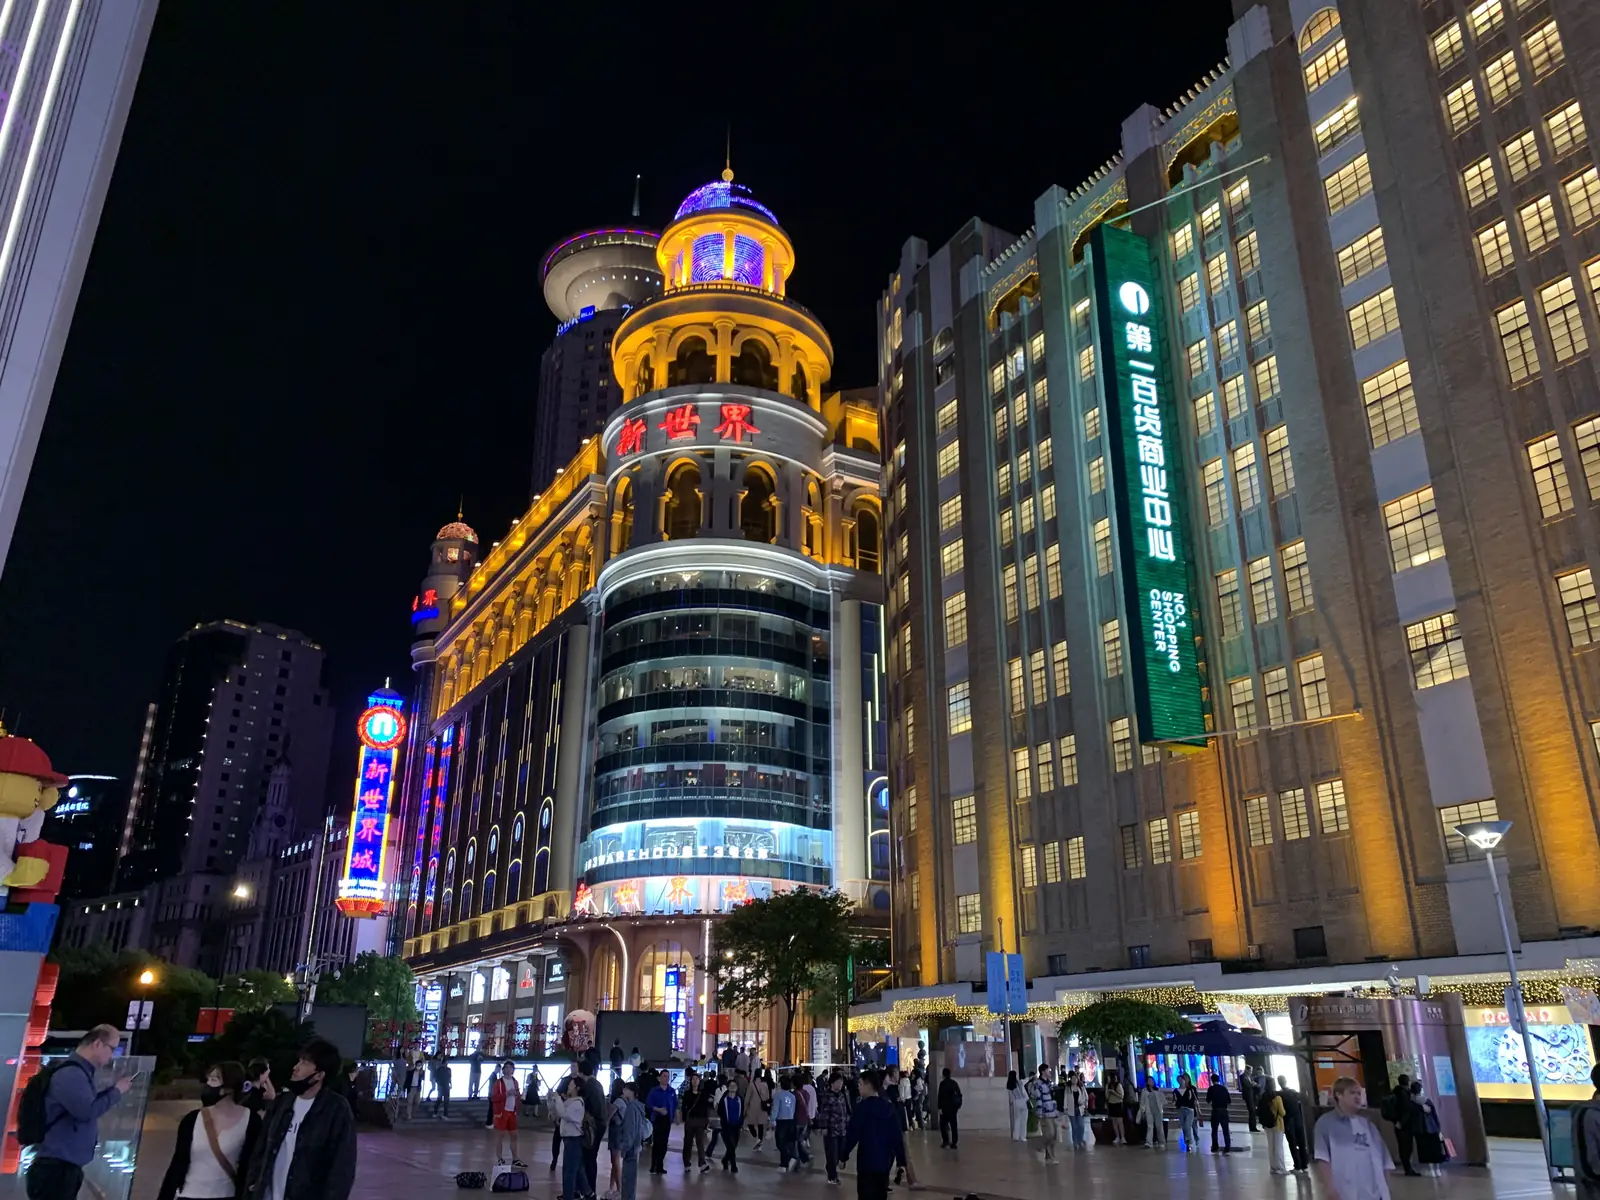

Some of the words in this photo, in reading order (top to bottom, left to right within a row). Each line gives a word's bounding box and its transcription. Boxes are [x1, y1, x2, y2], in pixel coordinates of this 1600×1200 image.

[615, 402, 762, 457] 新世界
[1126, 321, 1176, 562] 第一百货商业中心
[1150, 588, 1167, 652] CENTER
[1162, 590, 1181, 672] SHOPPING
[1173, 592, 1187, 628] NO.1
[351, 758, 389, 873] 新世界城
[1172, 1044, 1197, 1053] POLICE
